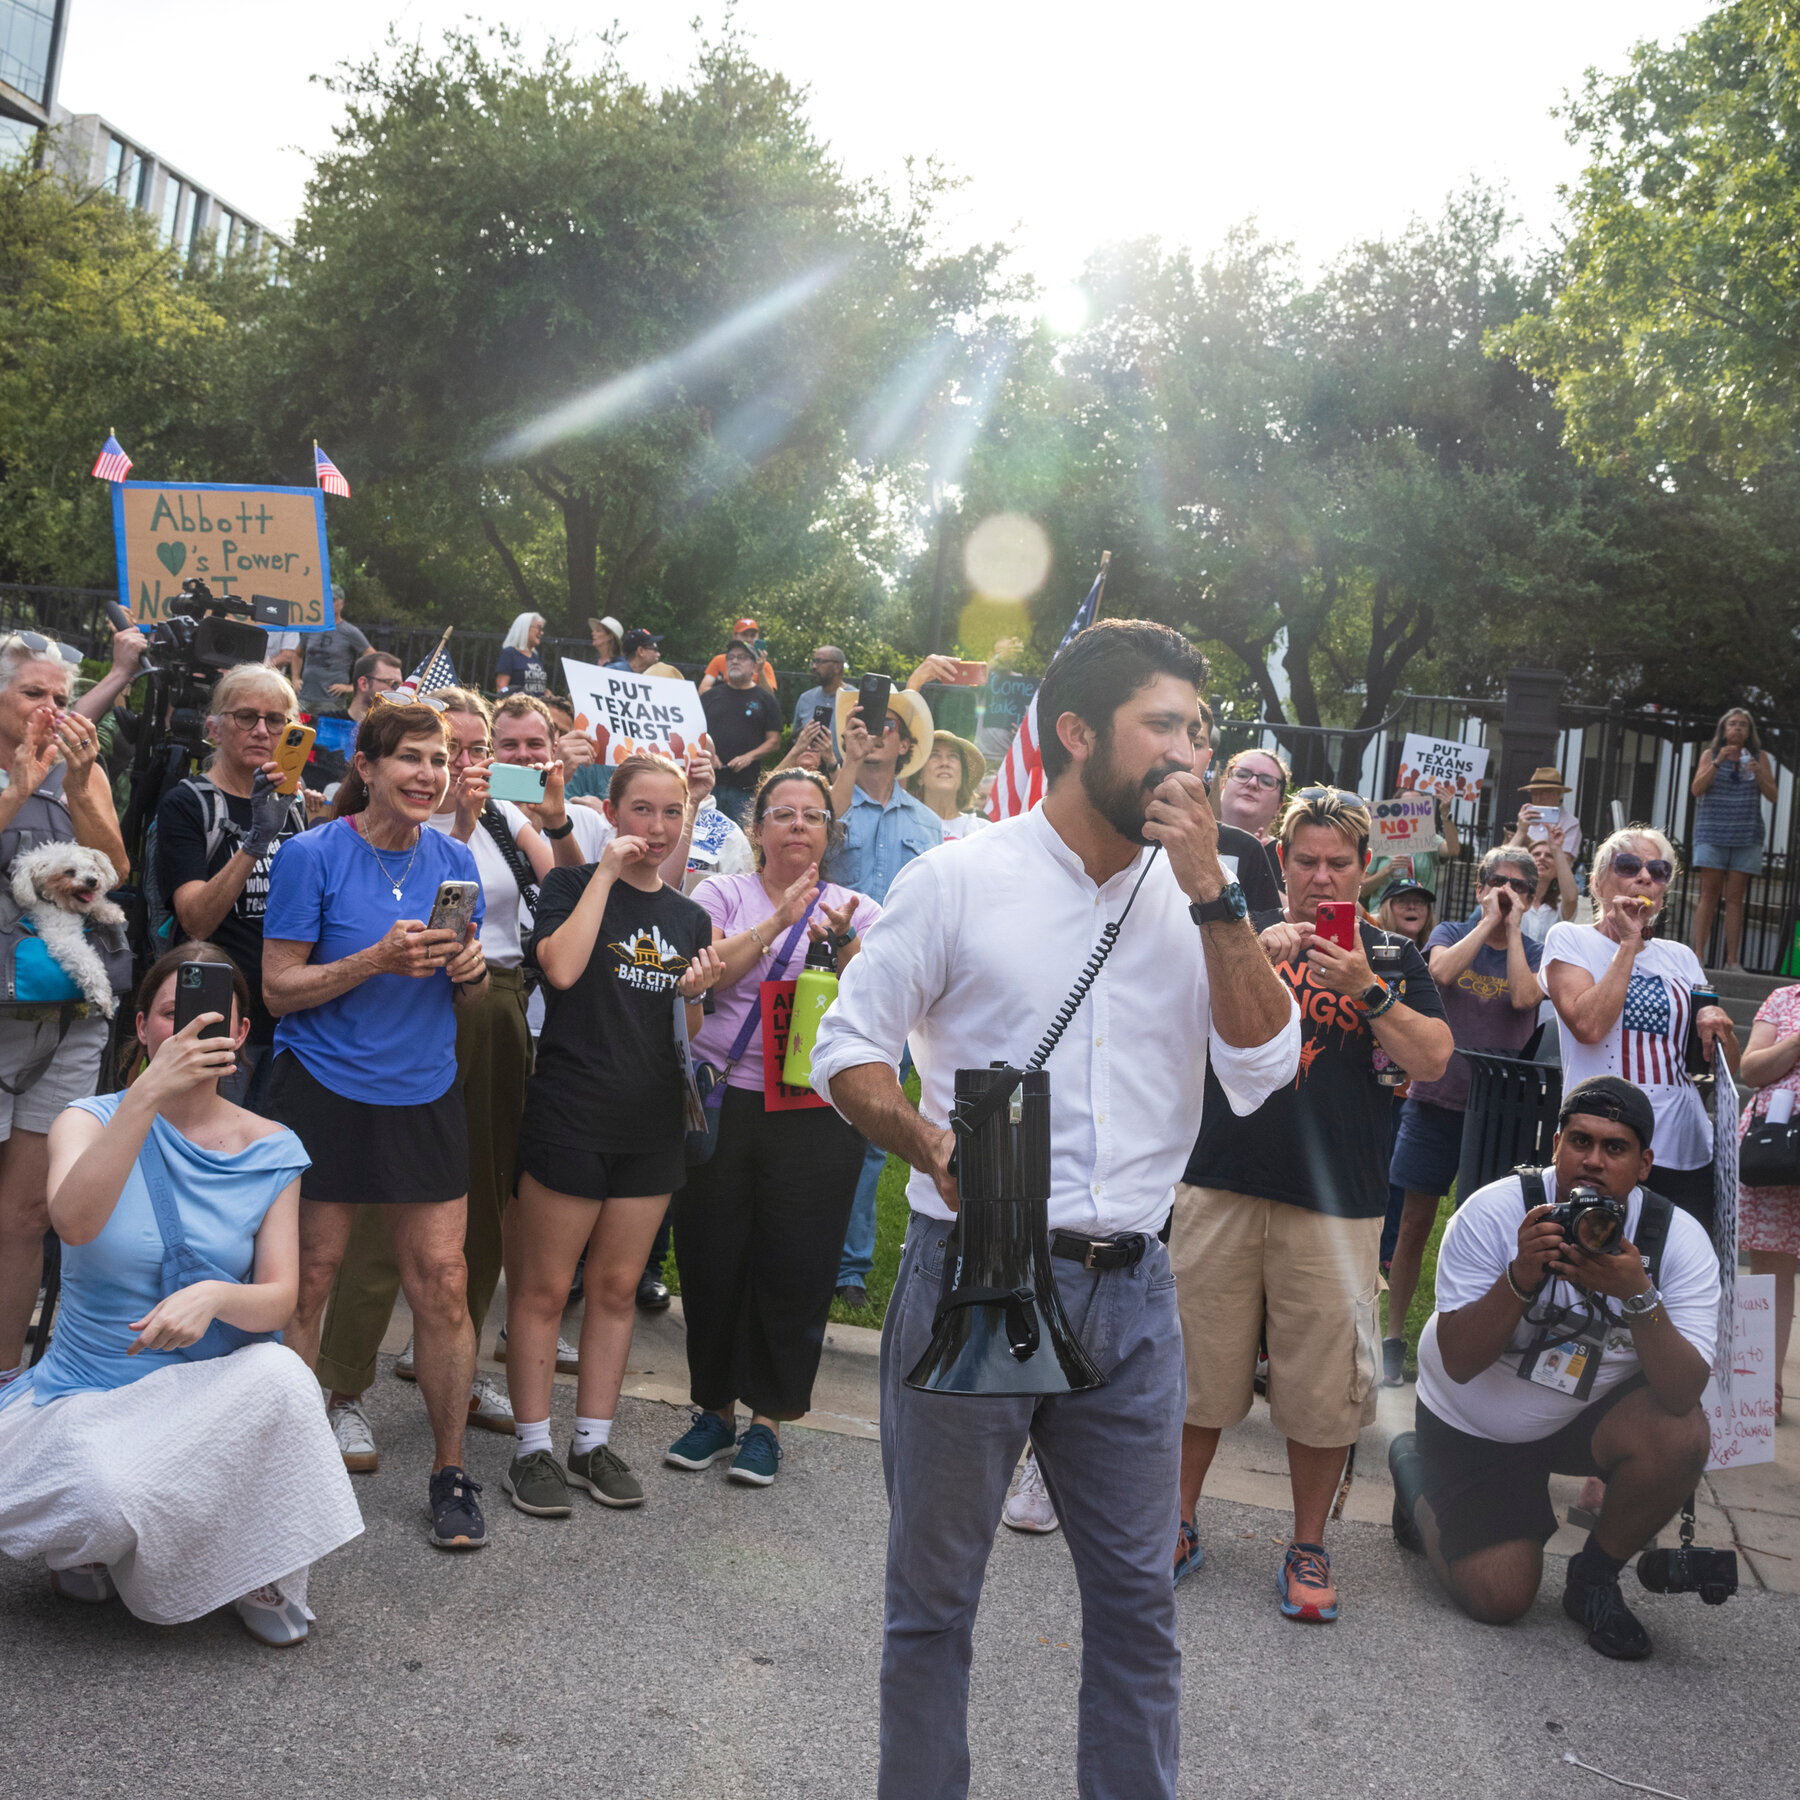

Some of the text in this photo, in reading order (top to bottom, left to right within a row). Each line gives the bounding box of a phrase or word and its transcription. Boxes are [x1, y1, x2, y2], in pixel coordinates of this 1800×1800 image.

[150, 493, 273, 534] Abbott
[222, 539, 310, 576] Power,
[608, 678, 653, 701] PUT
[990, 674, 1035, 697] Come
[590, 693, 684, 723] TEXANS
[990, 696, 1018, 716] take
[609, 716, 672, 741] FIRST
[1416, 752, 1474, 772] TEXANS
[1433, 744, 1462, 758] PUT
[1422, 764, 1464, 780] FIRST
[1380, 818, 1419, 835] NOT
[618, 963, 679, 989] BAT CITY
[630, 982, 664, 992] ARCHERY
